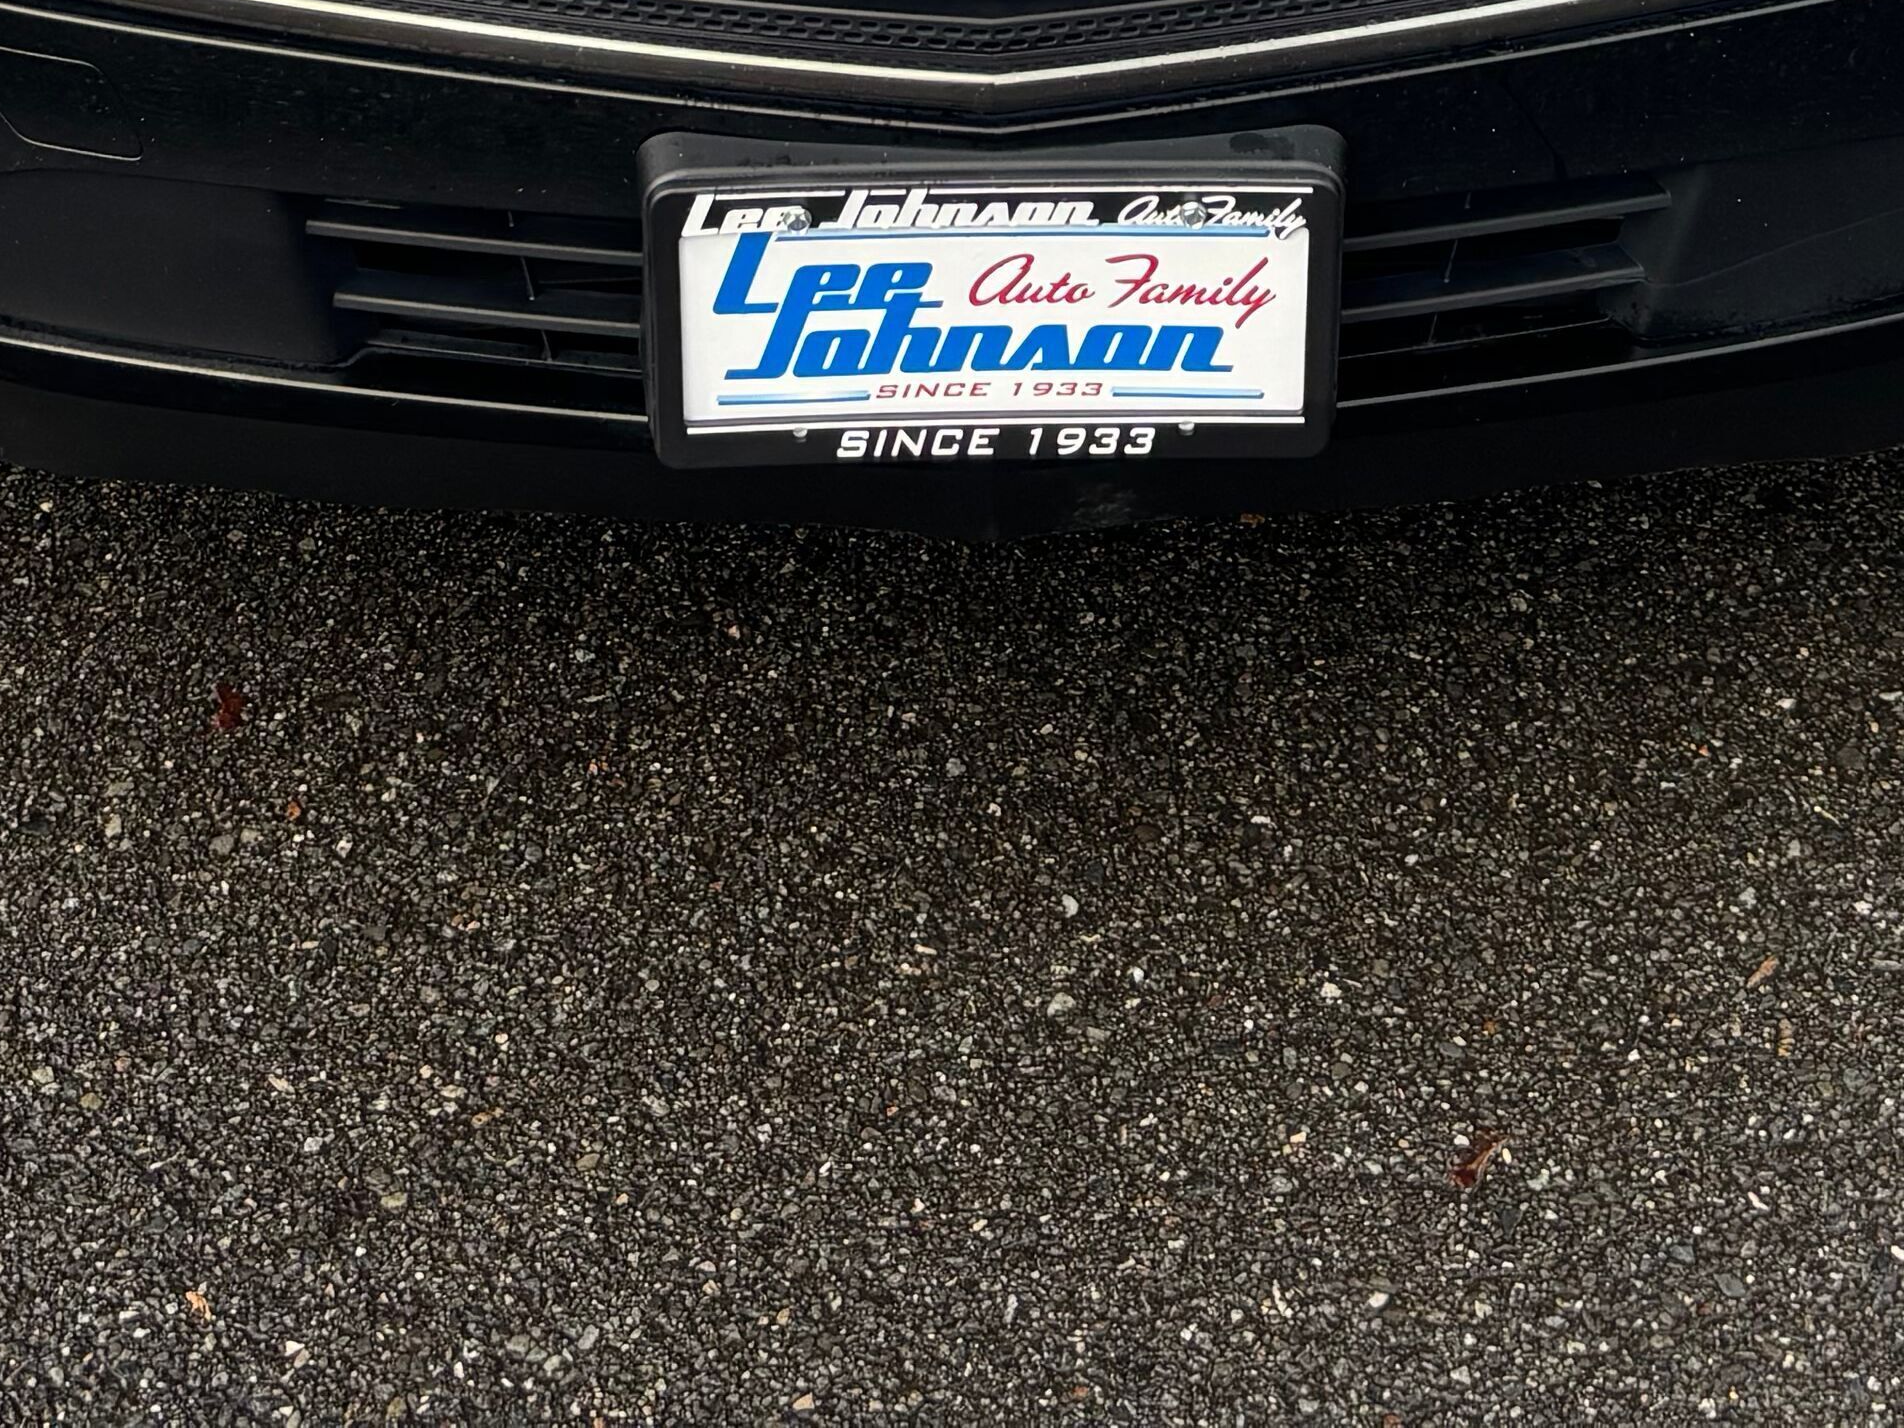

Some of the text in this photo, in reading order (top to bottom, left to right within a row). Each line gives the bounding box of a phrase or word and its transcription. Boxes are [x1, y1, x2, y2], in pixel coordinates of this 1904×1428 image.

[817, 188, 1100, 228] Johnson
[1200, 195, 1307, 240] Family
[713, 232, 1276, 329] Lee Auto Family
[725, 302, 1234, 381] Johnson
[876, 381, 1103, 399] SINCE 1933
[836, 427, 1156, 458] SINCE 1933
